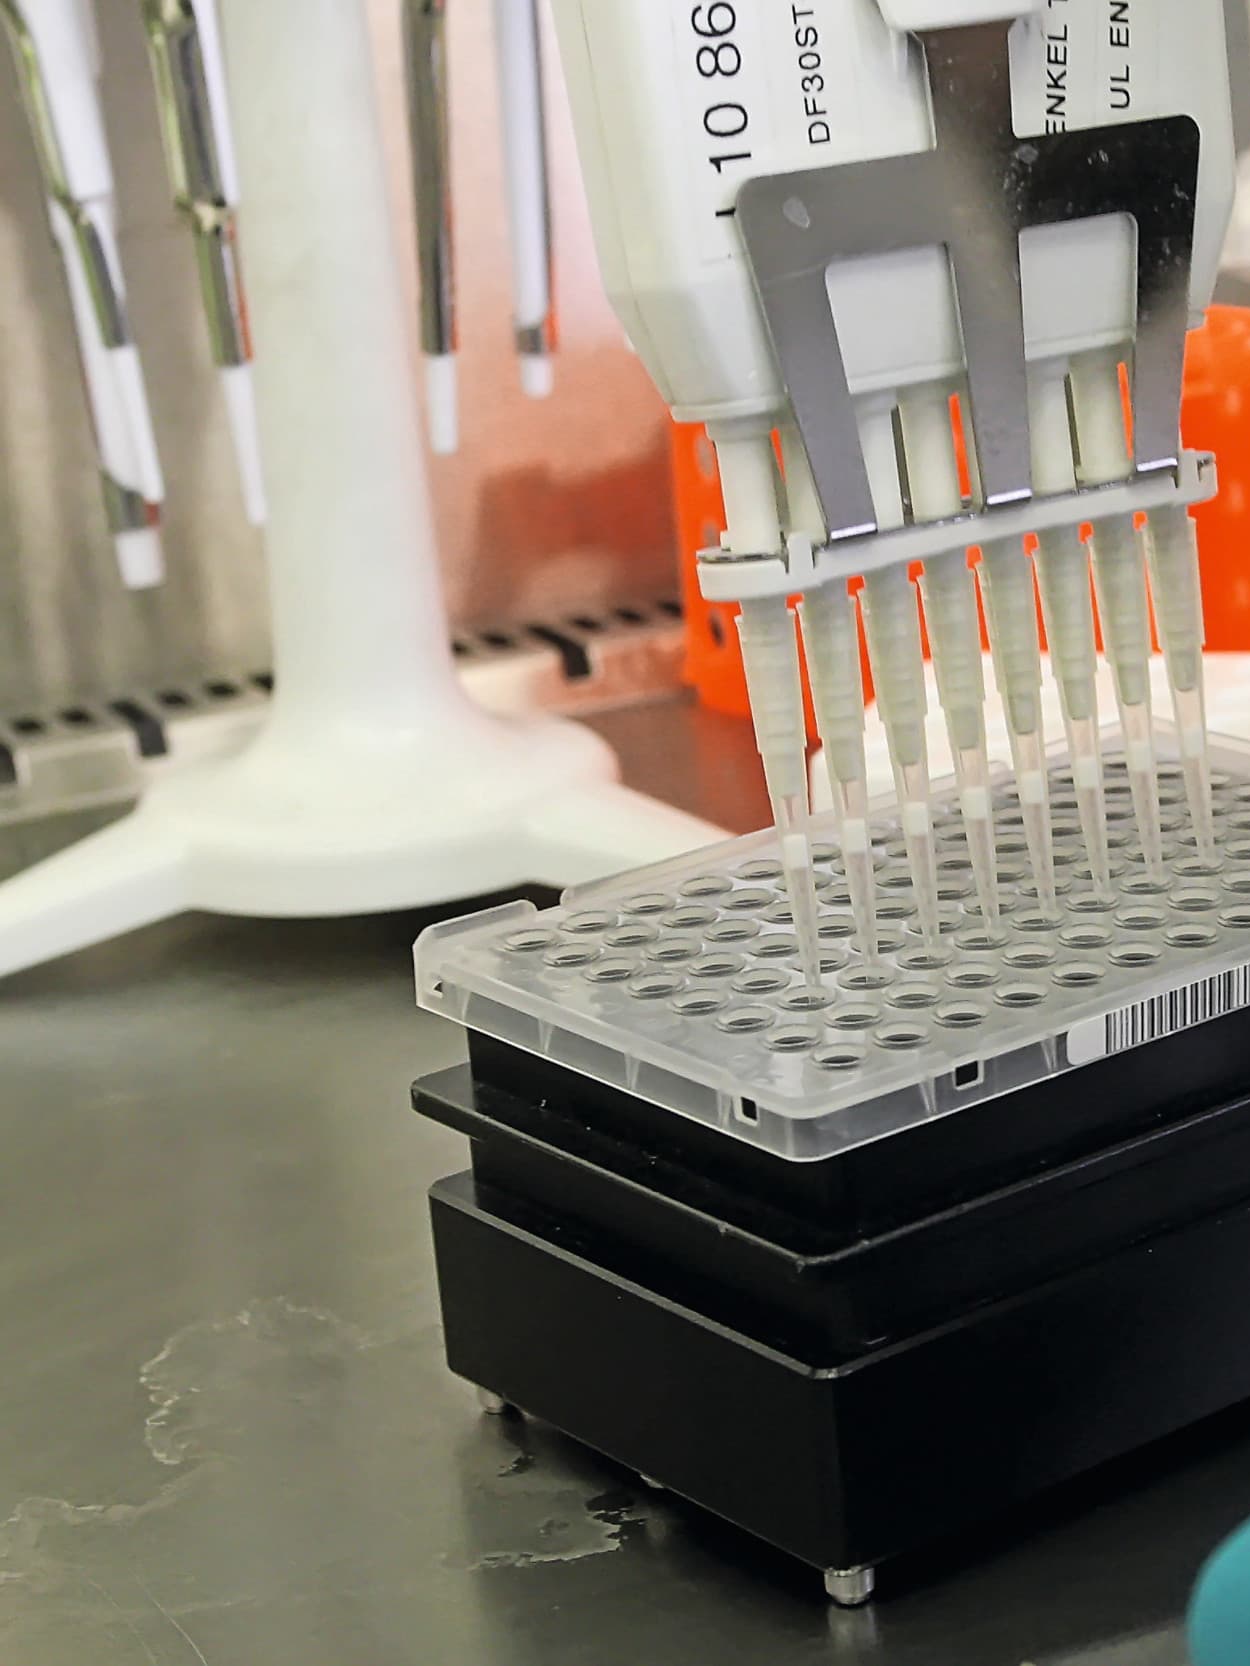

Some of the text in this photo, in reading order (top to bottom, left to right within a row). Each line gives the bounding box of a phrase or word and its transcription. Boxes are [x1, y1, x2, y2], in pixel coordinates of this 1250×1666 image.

[691, 2, 742, 78] 86
[792, 4, 831, 145] DF30ST
[1109, 1, 1130, 109] UL EN
[703, 103, 752, 174] 10
